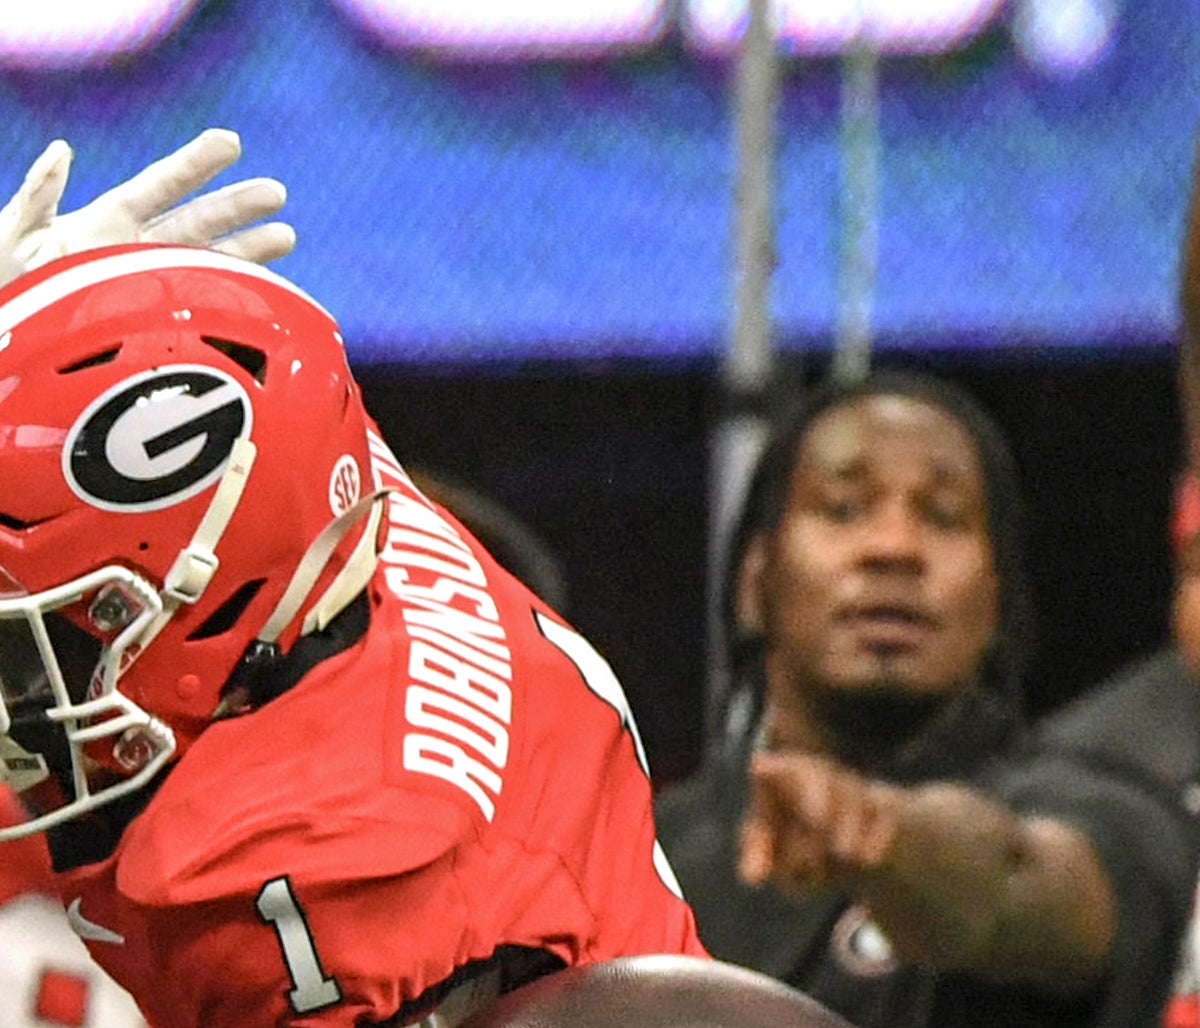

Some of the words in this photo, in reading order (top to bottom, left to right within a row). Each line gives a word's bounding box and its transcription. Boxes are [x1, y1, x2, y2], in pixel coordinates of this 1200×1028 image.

[70, 371, 245, 505] G
[334, 463, 356, 510] SEC
[381, 490, 512, 823] ROBINSON
[256, 874, 342, 1014] 1
